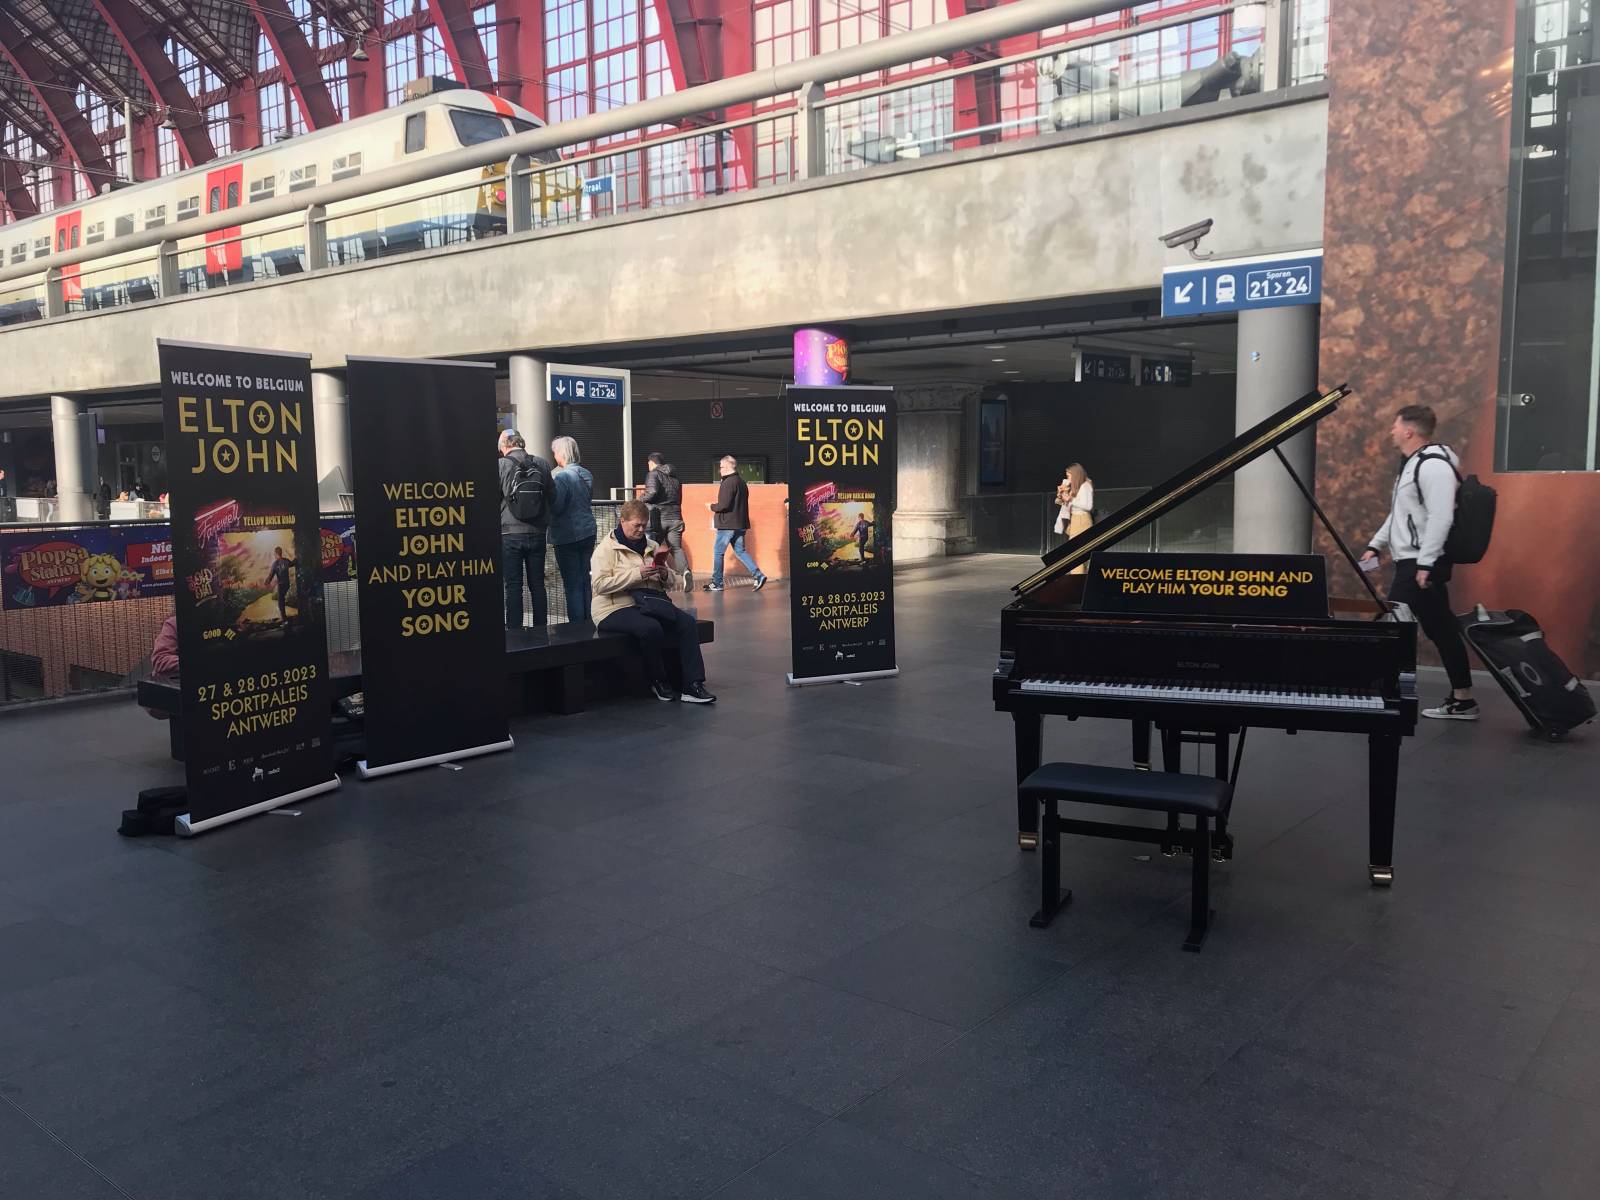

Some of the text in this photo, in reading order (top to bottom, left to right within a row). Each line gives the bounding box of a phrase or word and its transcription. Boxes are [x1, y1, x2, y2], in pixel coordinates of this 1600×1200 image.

[1266, 271, 1291, 280] Sporen
[171, 371, 304, 392] WELCOME TO BELGIUM
[178, 396, 302, 435] ELTON
[794, 403, 886, 413] WELCOME TO BELGIUM
[797, 418, 883, 441] ELTON
[192, 438, 298, 474] JOHN
[804, 443, 879, 466] JOHN
[383, 481, 475, 501] WELCOME
[198, 503, 242, 548] Farewell
[243, 514, 296, 526] YELLOW BRICK ROAD
[396, 505, 466, 529] ELTON
[399, 532, 464, 557] JOHN
[368, 557, 494, 585] AND PLAY HIM
[1101, 568, 1313, 584] WELCOME ELTON JOHN AND
[402, 584, 467, 609] YOUR
[801, 591, 885, 606] 27 & 28.05.2023
[1122, 582, 1288, 598] PLAY HIM YOUR SONG
[810, 603, 878, 618] SPORTPALEIS
[401, 610, 470, 637] SONG
[819, 617, 869, 631] ANTWERP
[198, 665, 317, 702] 27 & 28.05.2023
[212, 684, 308, 720] SPORTPALEIS
[227, 707, 297, 738] ANTWERP
